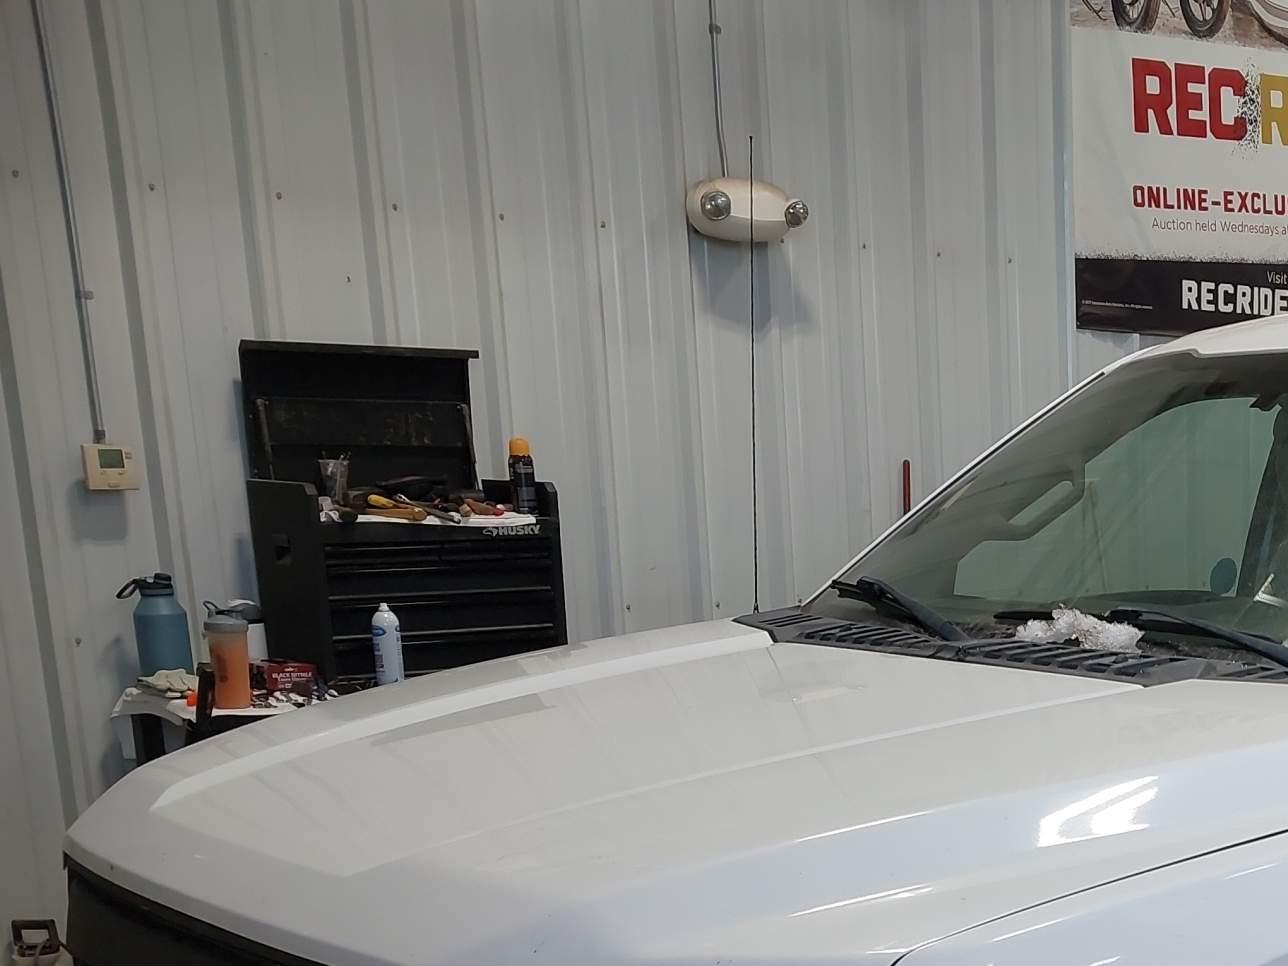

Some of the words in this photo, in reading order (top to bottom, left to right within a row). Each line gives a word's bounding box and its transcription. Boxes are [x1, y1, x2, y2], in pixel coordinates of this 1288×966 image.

[1151, 217, 1192, 231] Auction
[1195, 219, 1217, 232] held
[1220, 221, 1279, 236] Wednesdays
[1267, 271, 1288, 285] Visit
[498, 525, 540, 535] HUSKY
